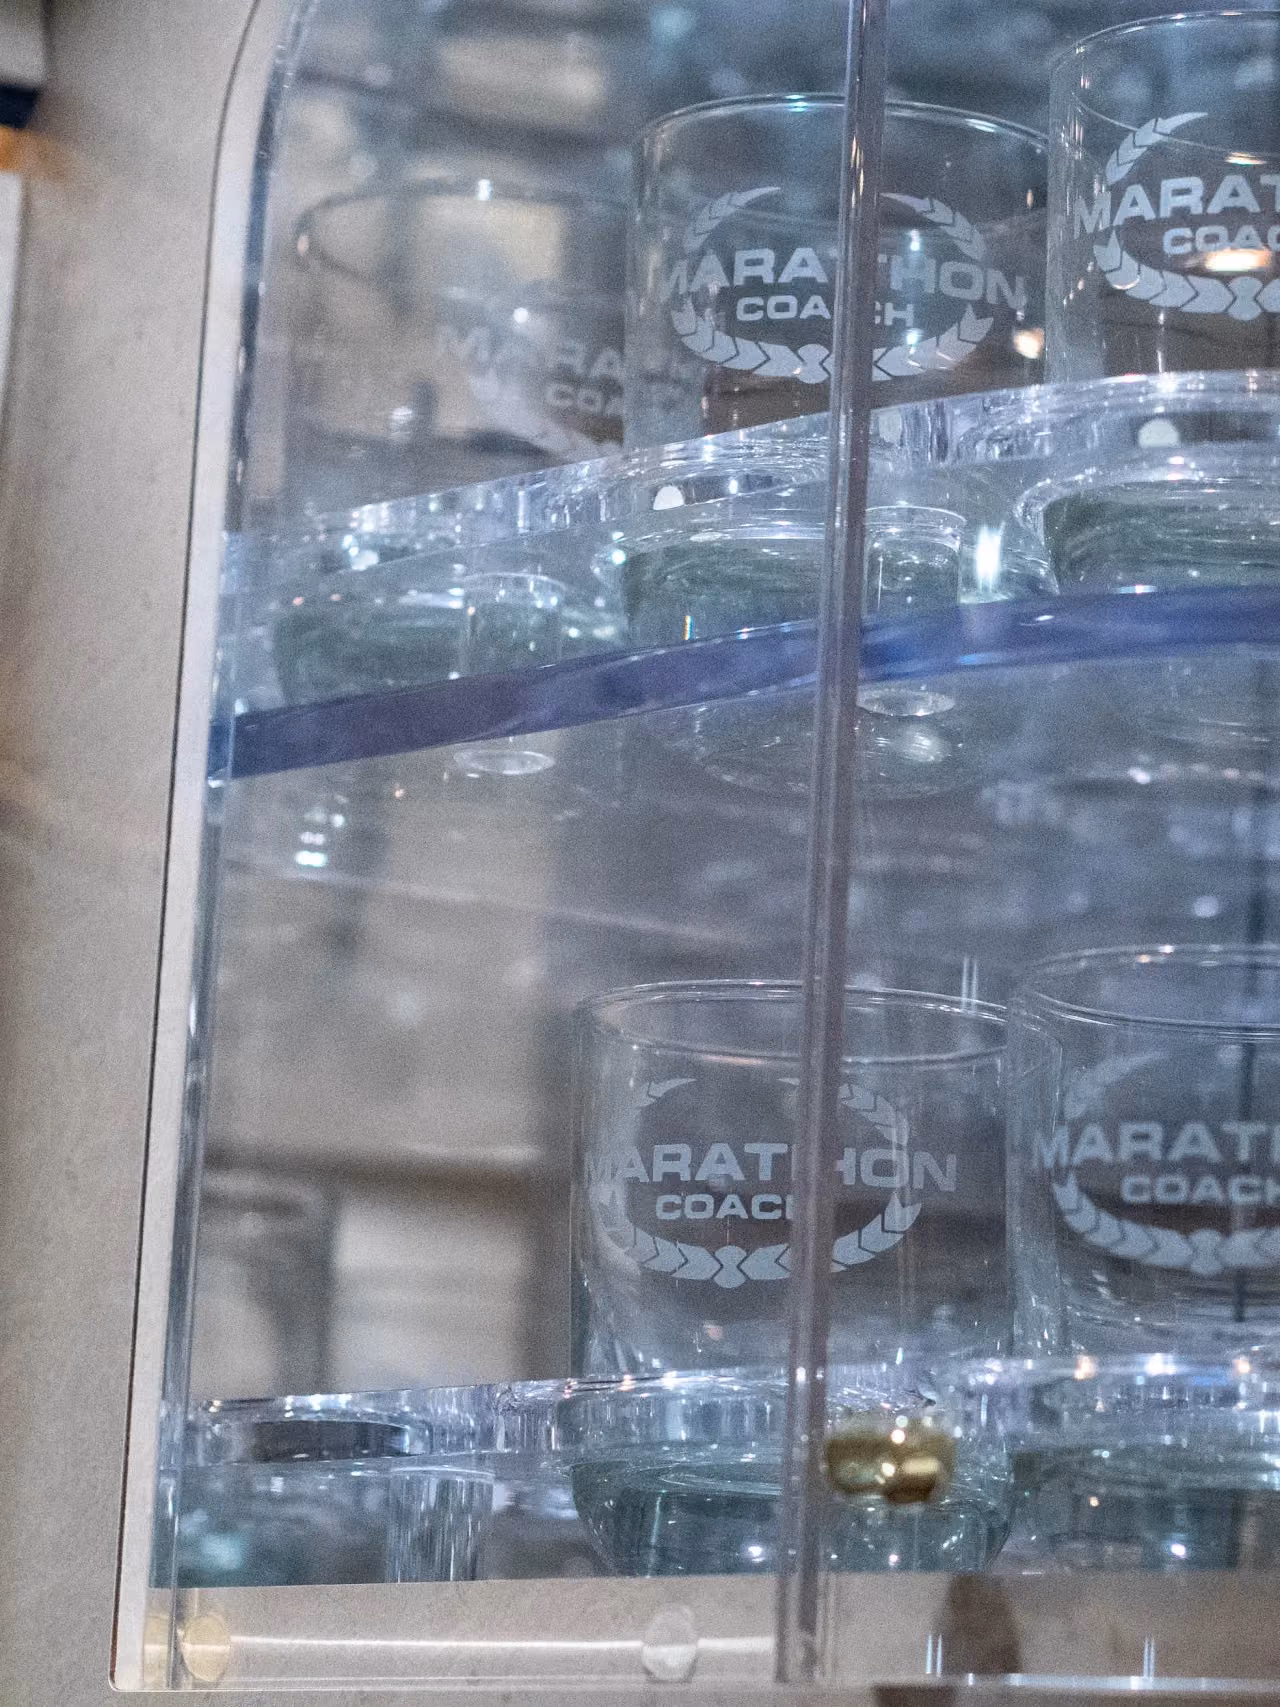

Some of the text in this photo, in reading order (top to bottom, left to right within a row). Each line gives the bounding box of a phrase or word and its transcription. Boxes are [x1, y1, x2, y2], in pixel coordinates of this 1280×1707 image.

[664, 247, 1026, 309] MARAHON
[736, 295, 914, 327] COAH
[655, 1194, 798, 1220] COAC
